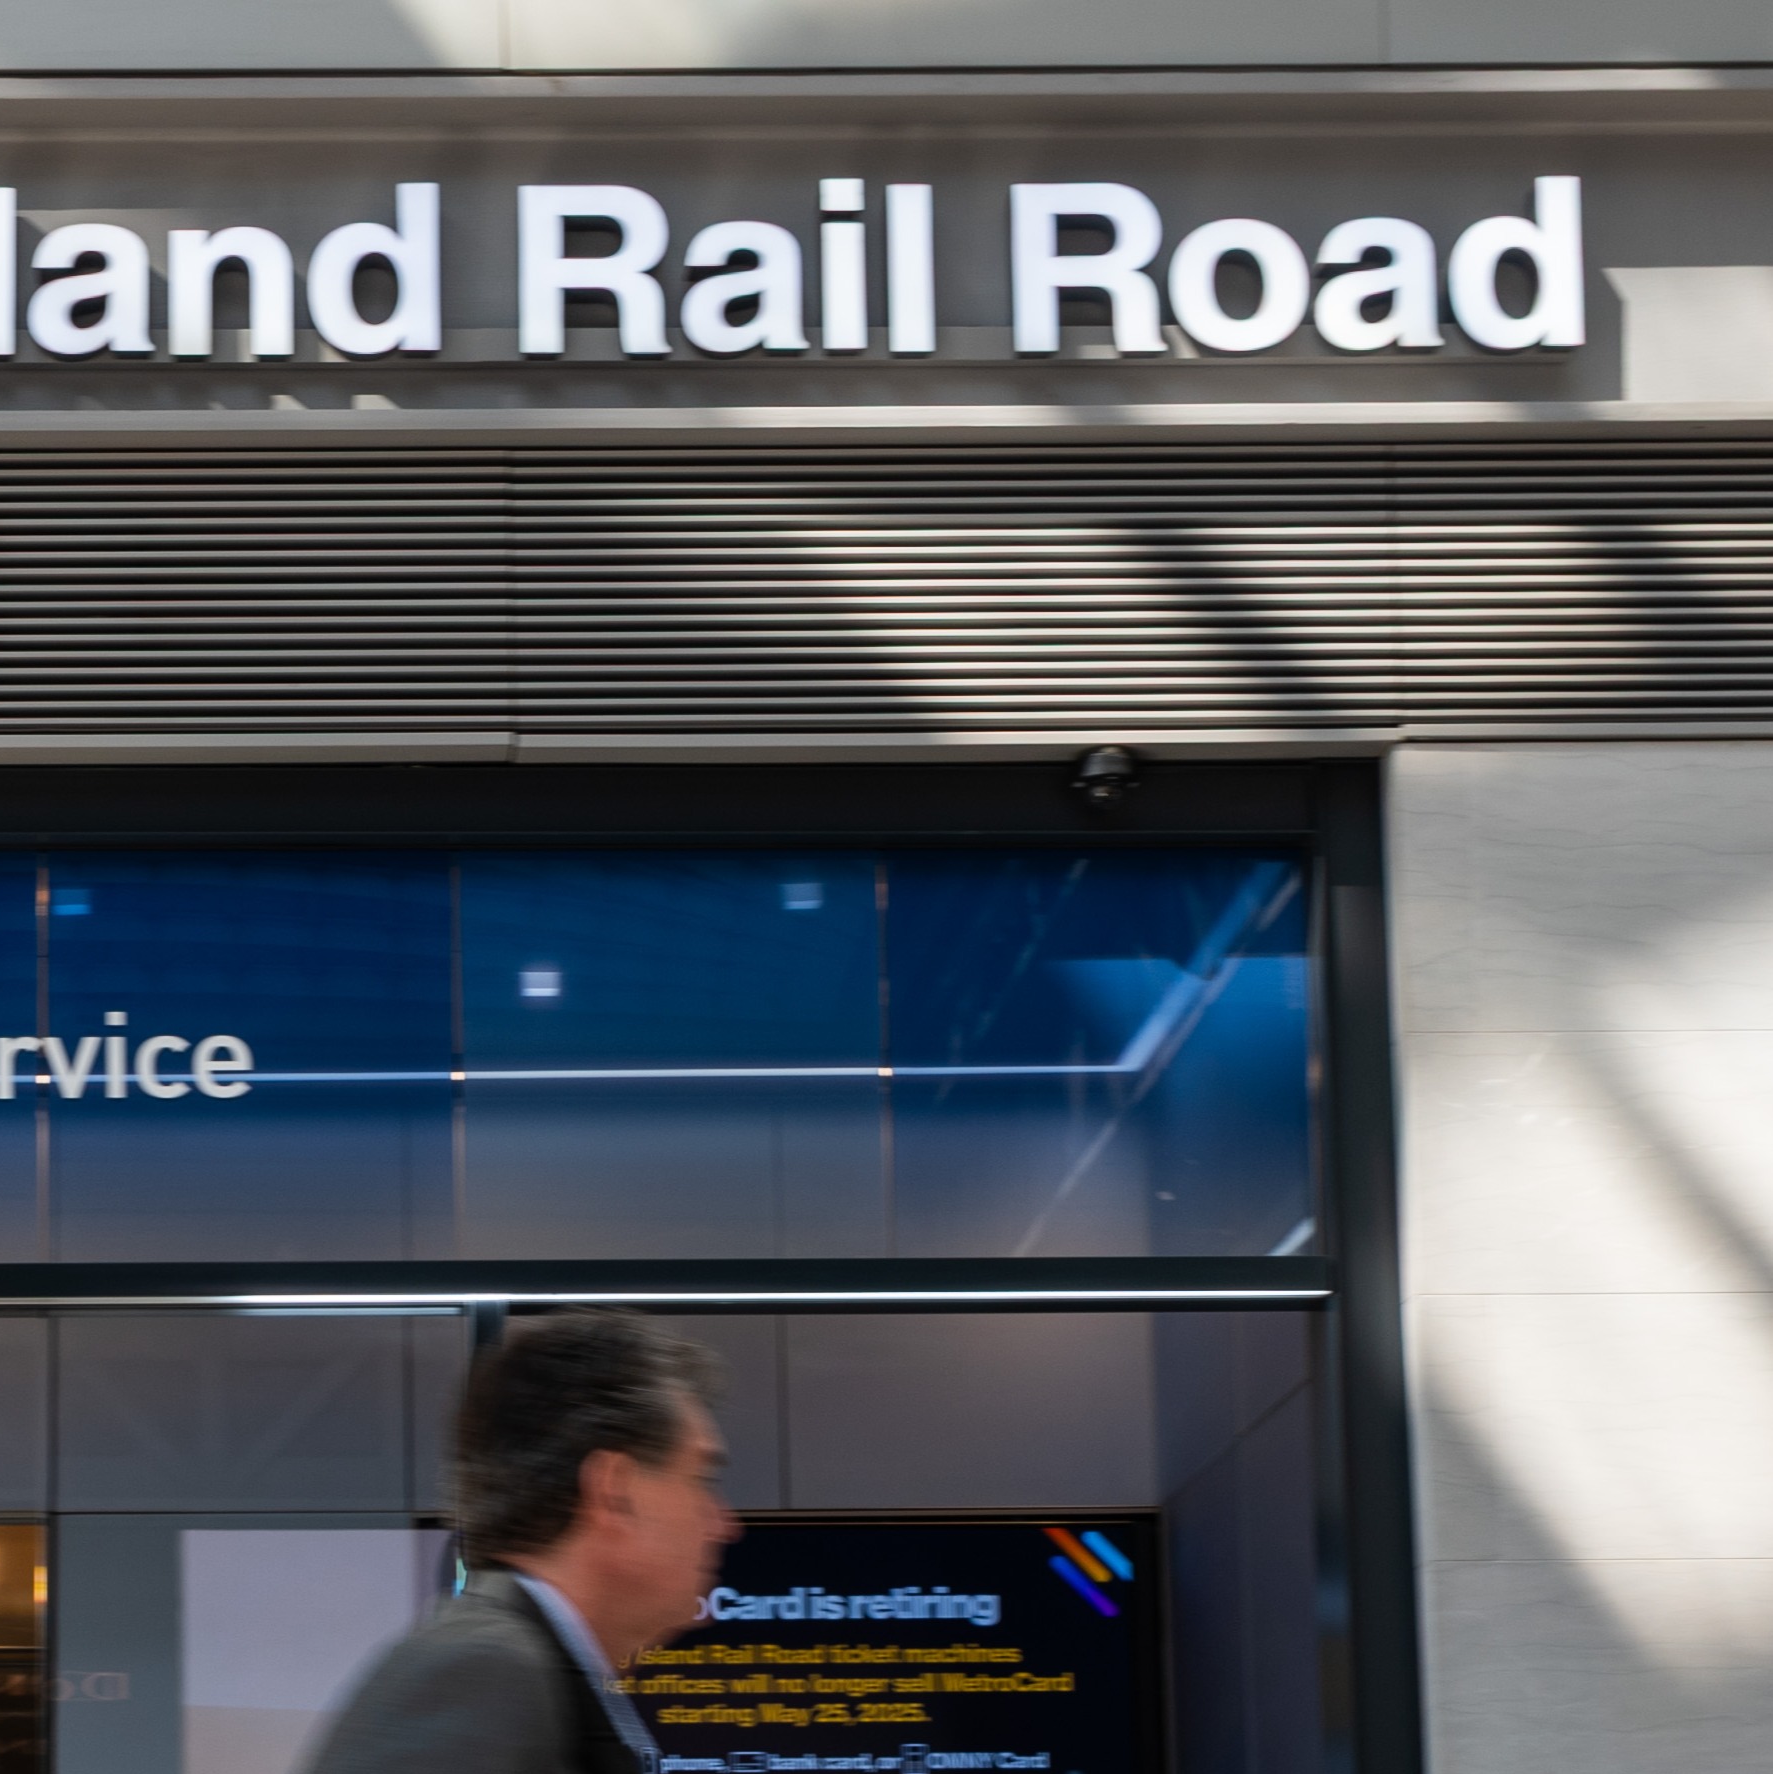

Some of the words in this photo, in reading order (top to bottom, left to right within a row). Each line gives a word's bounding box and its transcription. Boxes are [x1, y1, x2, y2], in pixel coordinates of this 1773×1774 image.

[517, 177, 937, 354] Rail
[1010, 175, 1587, 353] Road
[808, 1586, 845, 1620] is
[847, 1585, 1001, 1626] retiring
[903, 1643, 1023, 1663] machines
